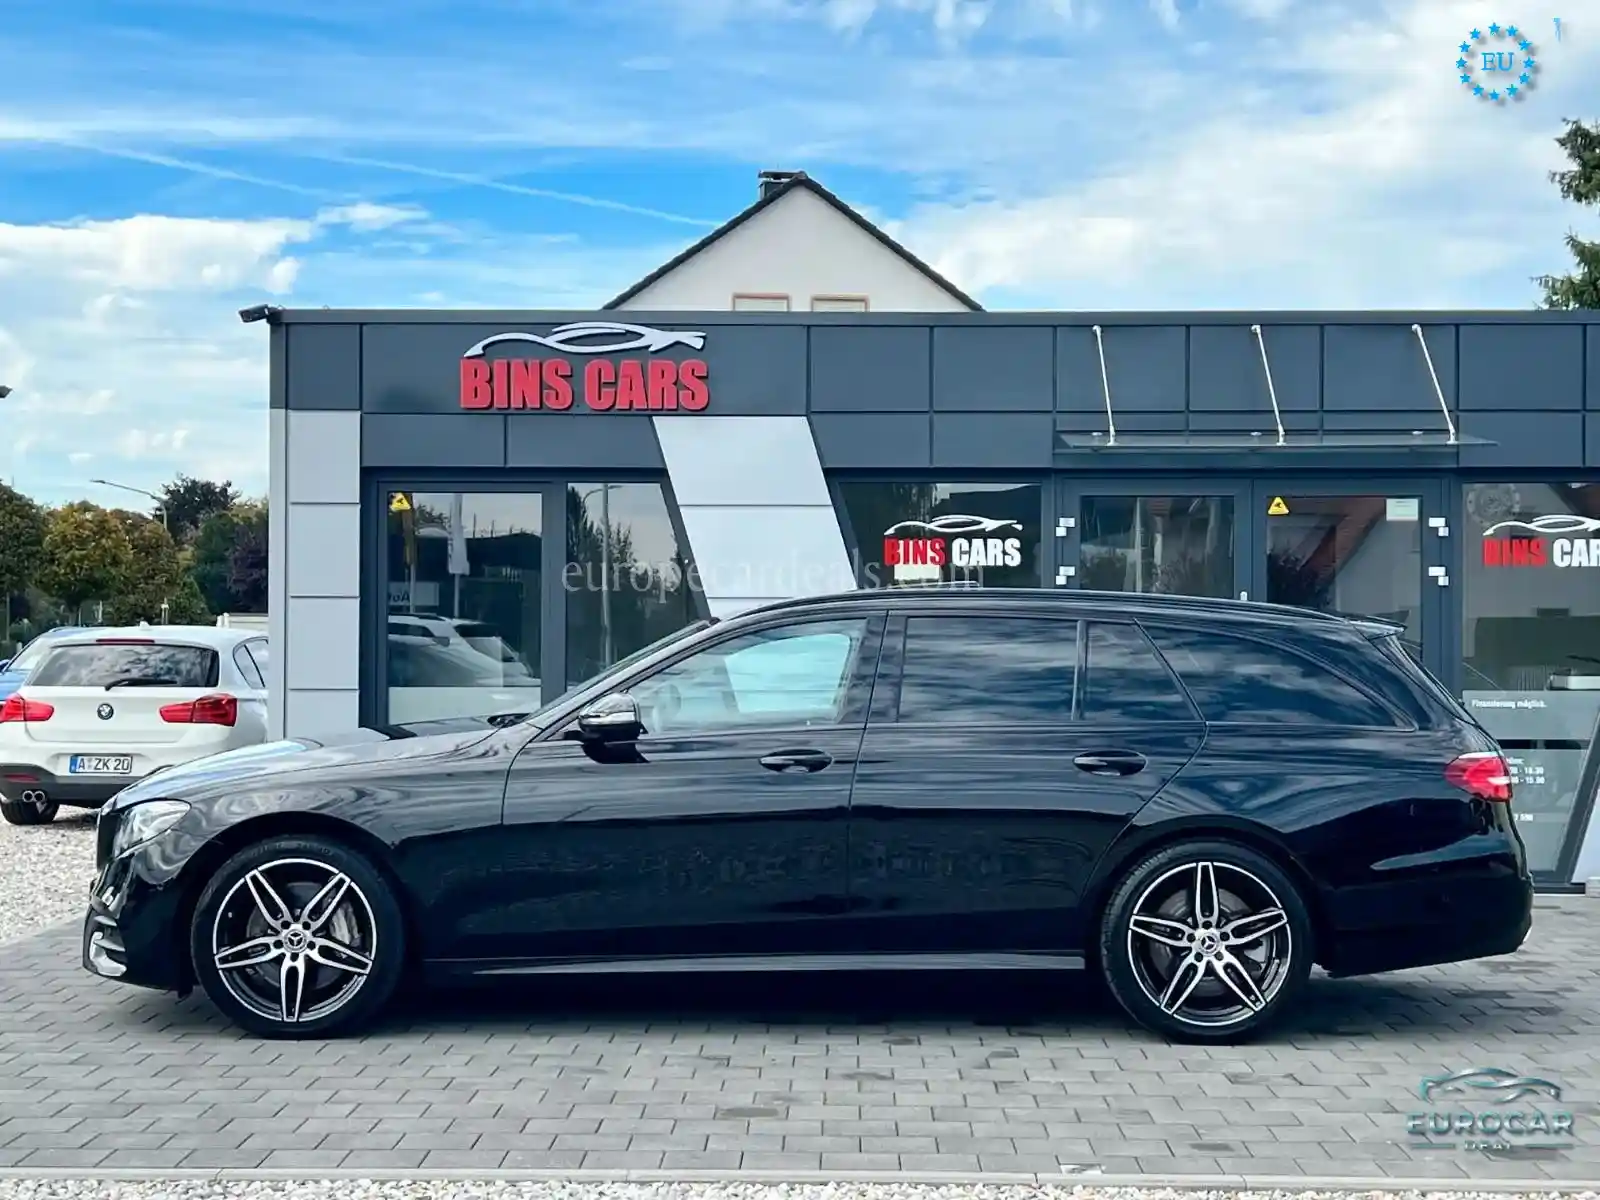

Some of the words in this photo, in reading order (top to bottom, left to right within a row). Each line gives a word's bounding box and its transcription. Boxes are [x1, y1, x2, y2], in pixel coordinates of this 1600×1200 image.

[460, 358, 573, 409] BINS
[584, 358, 709, 410] CARS
[883, 536, 946, 566] BINS
[951, 537, 1022, 567] CARS
[1482, 538, 1547, 567] BINS
[78, 758, 85, 770] A
[94, 758, 111, 770] ZK
[114, 758, 130, 770] 20
